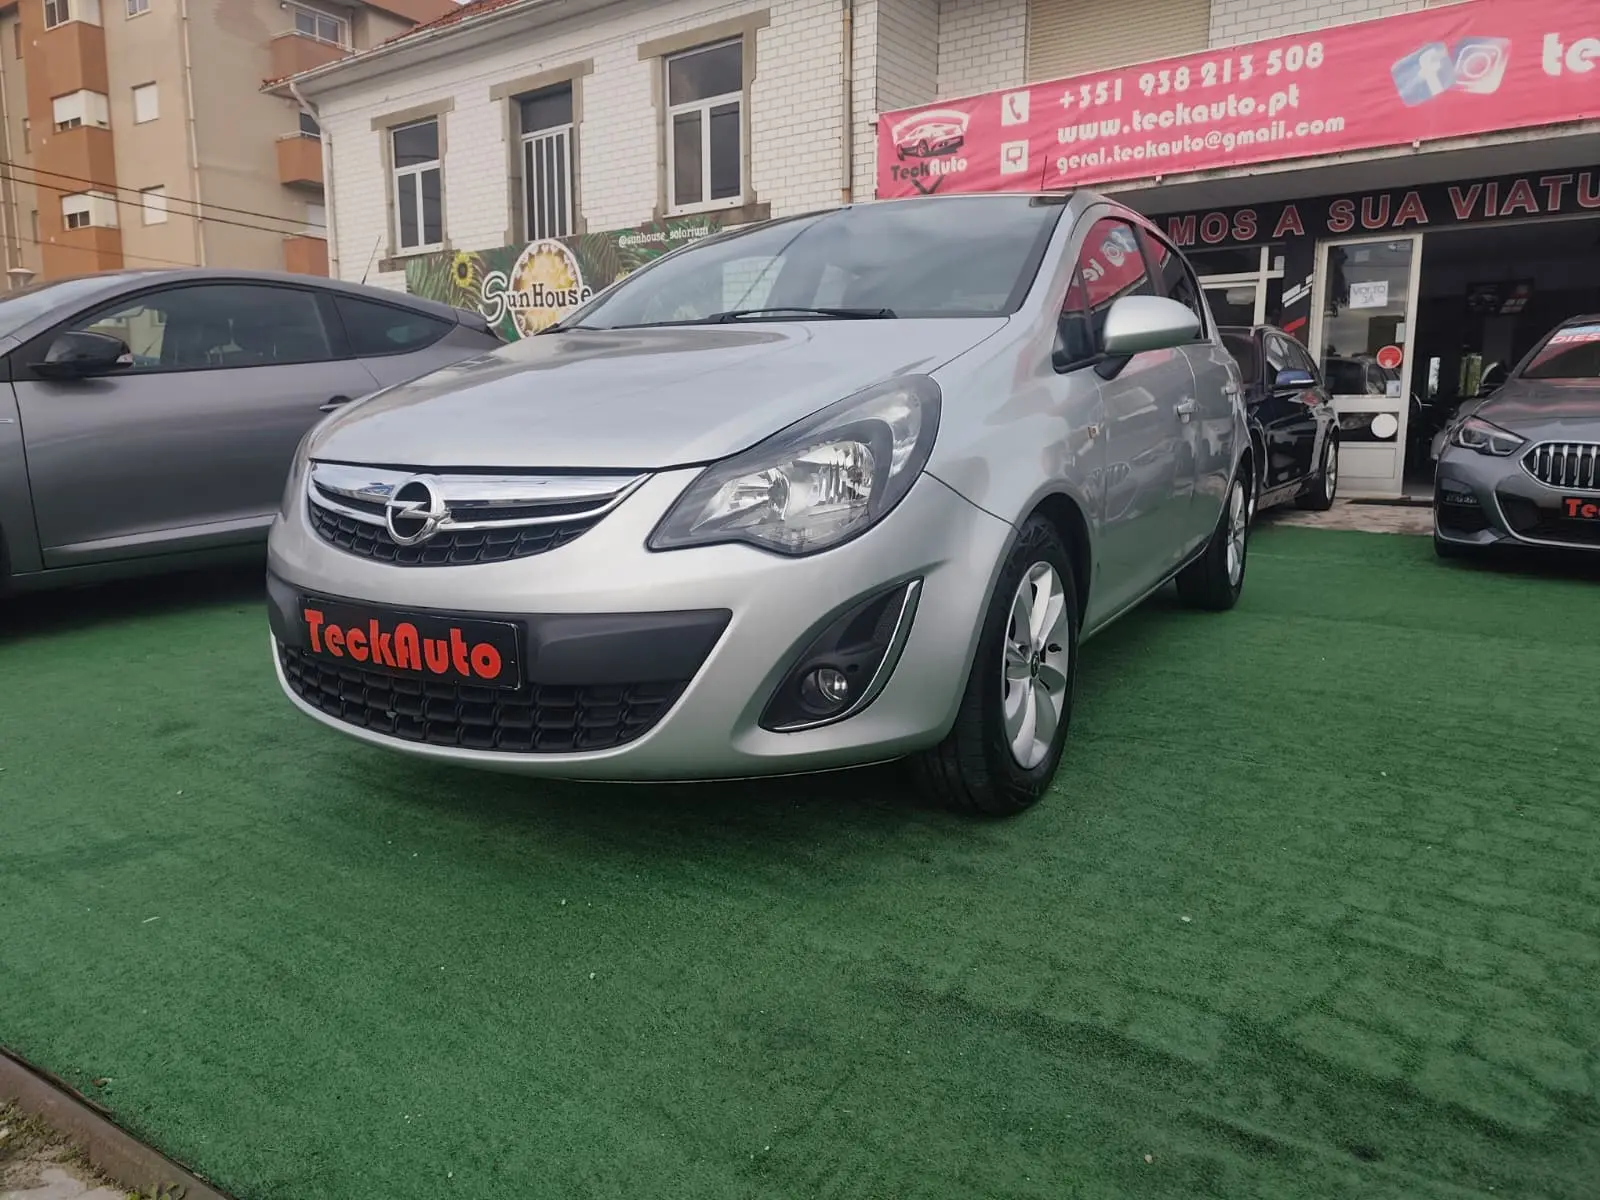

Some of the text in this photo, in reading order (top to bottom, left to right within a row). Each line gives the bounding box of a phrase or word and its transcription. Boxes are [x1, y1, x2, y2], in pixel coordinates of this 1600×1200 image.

[1059, 42, 1325, 109] +351 938 213 508
[1056, 83, 1300, 145] www.teckauto.pt
[1056, 115, 1346, 176] geral.teckauto@gmail.com
[1151, 208, 1258, 247] MOS
[1272, 204, 1306, 238] A
[1326, 190, 1429, 233] SUA
[478, 271, 593, 327] SunHouse
[1566, 498, 1600, 518] Te
[304, 608, 502, 680] TeckAuto
